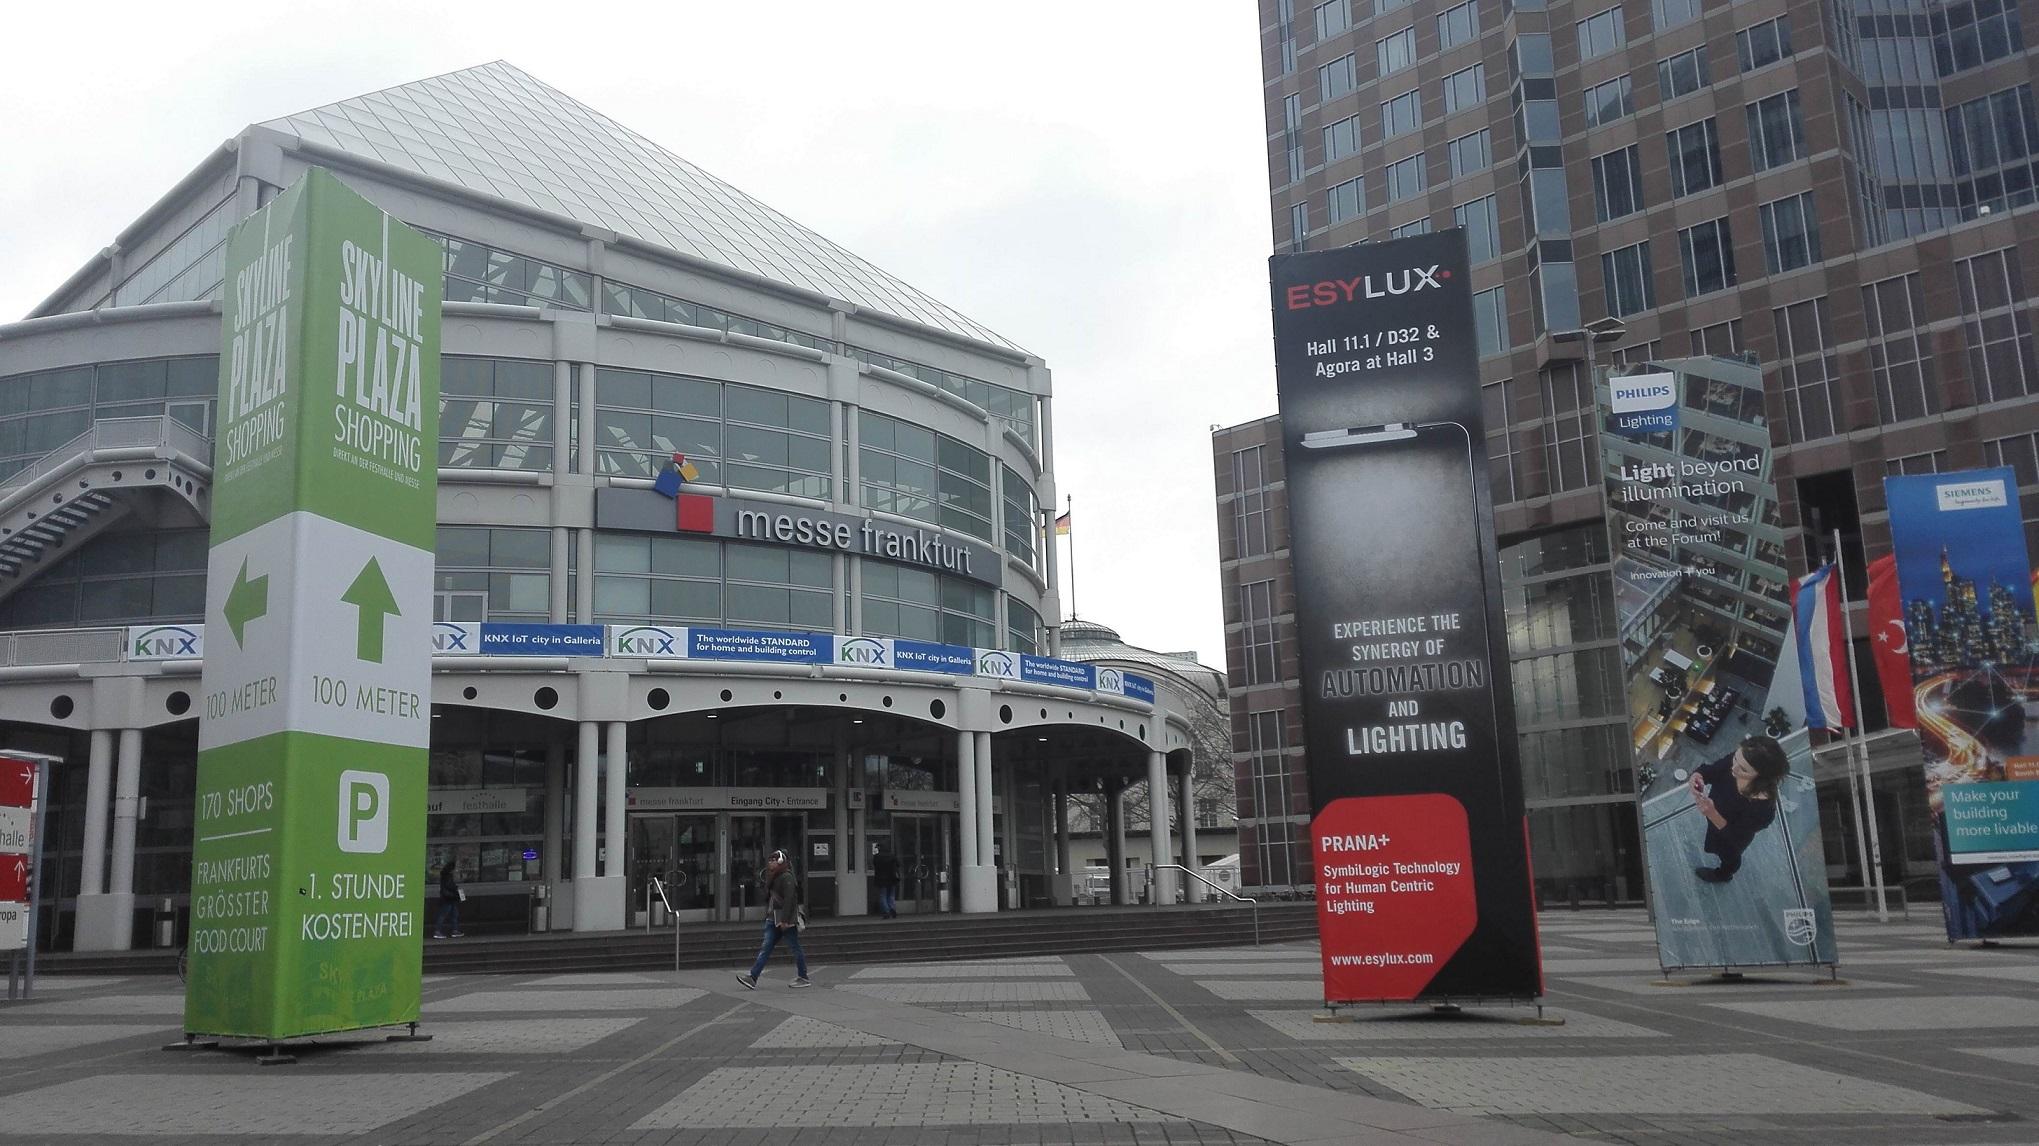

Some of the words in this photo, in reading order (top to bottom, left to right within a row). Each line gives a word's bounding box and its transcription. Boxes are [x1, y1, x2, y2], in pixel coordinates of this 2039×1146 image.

[234, 203, 293, 333] SKYLINE
[340, 211, 424, 344] SKYLINE
[1287, 264, 1442, 310] ESYLUX
[1307, 339, 1337, 356] Hall
[1344, 334, 1370, 350] 11.1
[1375, 331, 1383, 347] /
[1388, 327, 1420, 345] D32
[1427, 324, 1440, 339] &
[228, 305, 286, 423] PLAZA
[336, 306, 422, 431] PLAZA
[1315, 360, 1361, 378] Agora
[1366, 355, 1383, 370] at
[1387, 349, 1417, 366] Hall
[1424, 347, 1434, 361] 3
[1616, 385, 1671, 400] PHILIPS
[1619, 414, 1673, 428] Lighting
[225, 400, 286, 466] SHOPPING
[334, 403, 421, 472] SHOPPING
[1620, 462, 1675, 483] Light
[1681, 454, 1760, 478] beyond
[1622, 479, 1745, 503] illumination
[1944, 487, 1992, 498] SIEMENS
[1625, 519, 1667, 533] Come
[1670, 515, 1697, 529] and
[1700, 512, 1728, 526] visit
[1732, 513, 1749, 525] us
[737, 508, 851, 549] messe
[861, 518, 974, 574] frankfurt
[1627, 536, 1642, 549] at
[1645, 533, 1669, 547] the
[1671, 530, 1721, 546] Forum!
[1695, 567, 1716, 578] you
[1334, 616, 1427, 639] EXPERIENCE
[1431, 613, 1461, 631] THE
[135, 638, 197, 656] KNX
[484, 633, 509, 644] KNX
[512, 634, 528, 644] IoT
[532, 634, 550, 646] city
[552, 635, 561, 645] in
[563, 635, 600, 646] Galleria
[618, 637, 675, 655] KNX
[696, 642, 709, 652] for
[711, 643, 735, 653] home
[737, 644, 753, 654] and
[755, 645, 787, 656] building
[788, 647, 817, 656] control
[697, 634, 714, 643] The
[716, 635, 759, 645] worldwide
[761, 636, 810, 647] STANDARD
[841, 647, 886, 664] KNX
[896, 651, 914, 660] KNX
[928, 655, 940, 664] city
[941, 655, 948, 663] in
[948, 656, 972, 666] Galleria
[1352, 640, 1420, 662] SYNERGY
[1425, 639, 1445, 656] OF
[979, 660, 1013, 677] KNX
[1025, 659, 1036, 668] The
[1036, 661, 1060, 671] worldwide
[1060, 665, 1085, 676] STANDARD
[1033, 669, 1047, 677] home
[1048, 671, 1057, 679] and
[1057, 672, 1074, 682] building
[1074, 675, 1089, 683] control
[1100, 676, 1121, 691] KNX
[1321, 659, 1484, 699] AUTOMATION
[206, 690, 226, 721] 100
[231, 676, 277, 714] METER
[313, 675, 347, 707] 100
[356, 684, 420, 720] METER
[1388, 700, 1419, 717] AND
[1347, 721, 1467, 755] LIGHTING
[202, 794, 221, 821] 170
[227, 782, 273, 817] SHOPS
[731, 796, 764, 808] Eingang
[765, 796, 781, 808] City
[786, 796, 819, 806] Entrance
[1952, 791, 1987, 803] Make
[1990, 790, 2020, 802] your
[348, 781, 379, 841] P
[1953, 807, 2008, 821] building
[1956, 825, 1991, 836] more
[1994, 821, 2038, 835] livable
[1321, 833, 1391, 852] PRANA+
[197, 854, 270, 885] FRANKFURTS
[1323, 862, 1390, 878] SymbiLogic
[1393, 861, 1461, 875] Technology
[309, 873, 322, 900] 1.
[331, 873, 405, 900] STUNDE
[1325, 882, 1341, 895] for
[1346, 881, 1387, 894] Human
[1391, 879, 1435, 893] Centric
[196, 889, 269, 919] GRÖSSTER
[1326, 899, 1375, 915] Lighting
[302, 912, 413, 940] KOSTENFREI
[1331, 952, 1434, 968] www.esylux.com
